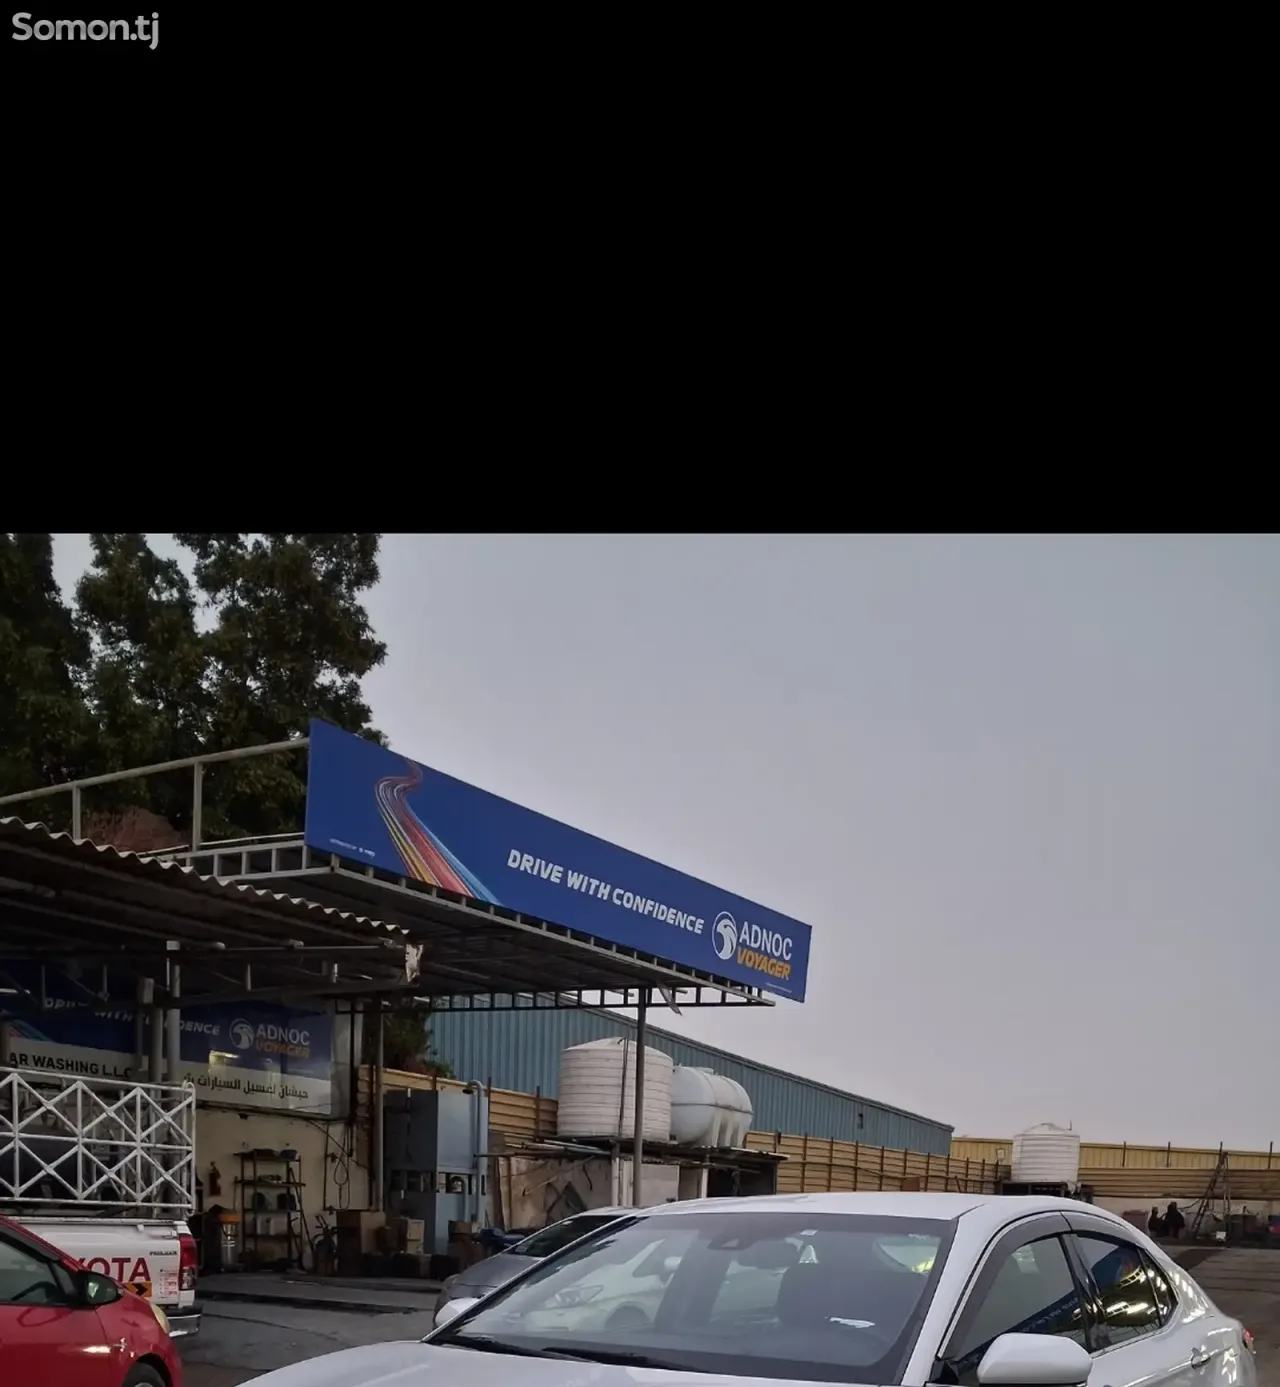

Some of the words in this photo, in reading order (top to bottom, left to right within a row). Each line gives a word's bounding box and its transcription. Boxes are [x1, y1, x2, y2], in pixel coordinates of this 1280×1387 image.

[507, 849, 563, 884] DRIVE
[566, 870, 611, 901] WITH
[612, 887, 705, 935] CONFIDENCE
[739, 921, 793, 961] ADNOC
[736, 946, 791, 980] VOYAGER
[256, 1023, 311, 1046] ADNOC
[9, 1052, 29, 1066] AR
[33, 1055, 98, 1075] WASHING
[79, 1257, 151, 1283] OTA
